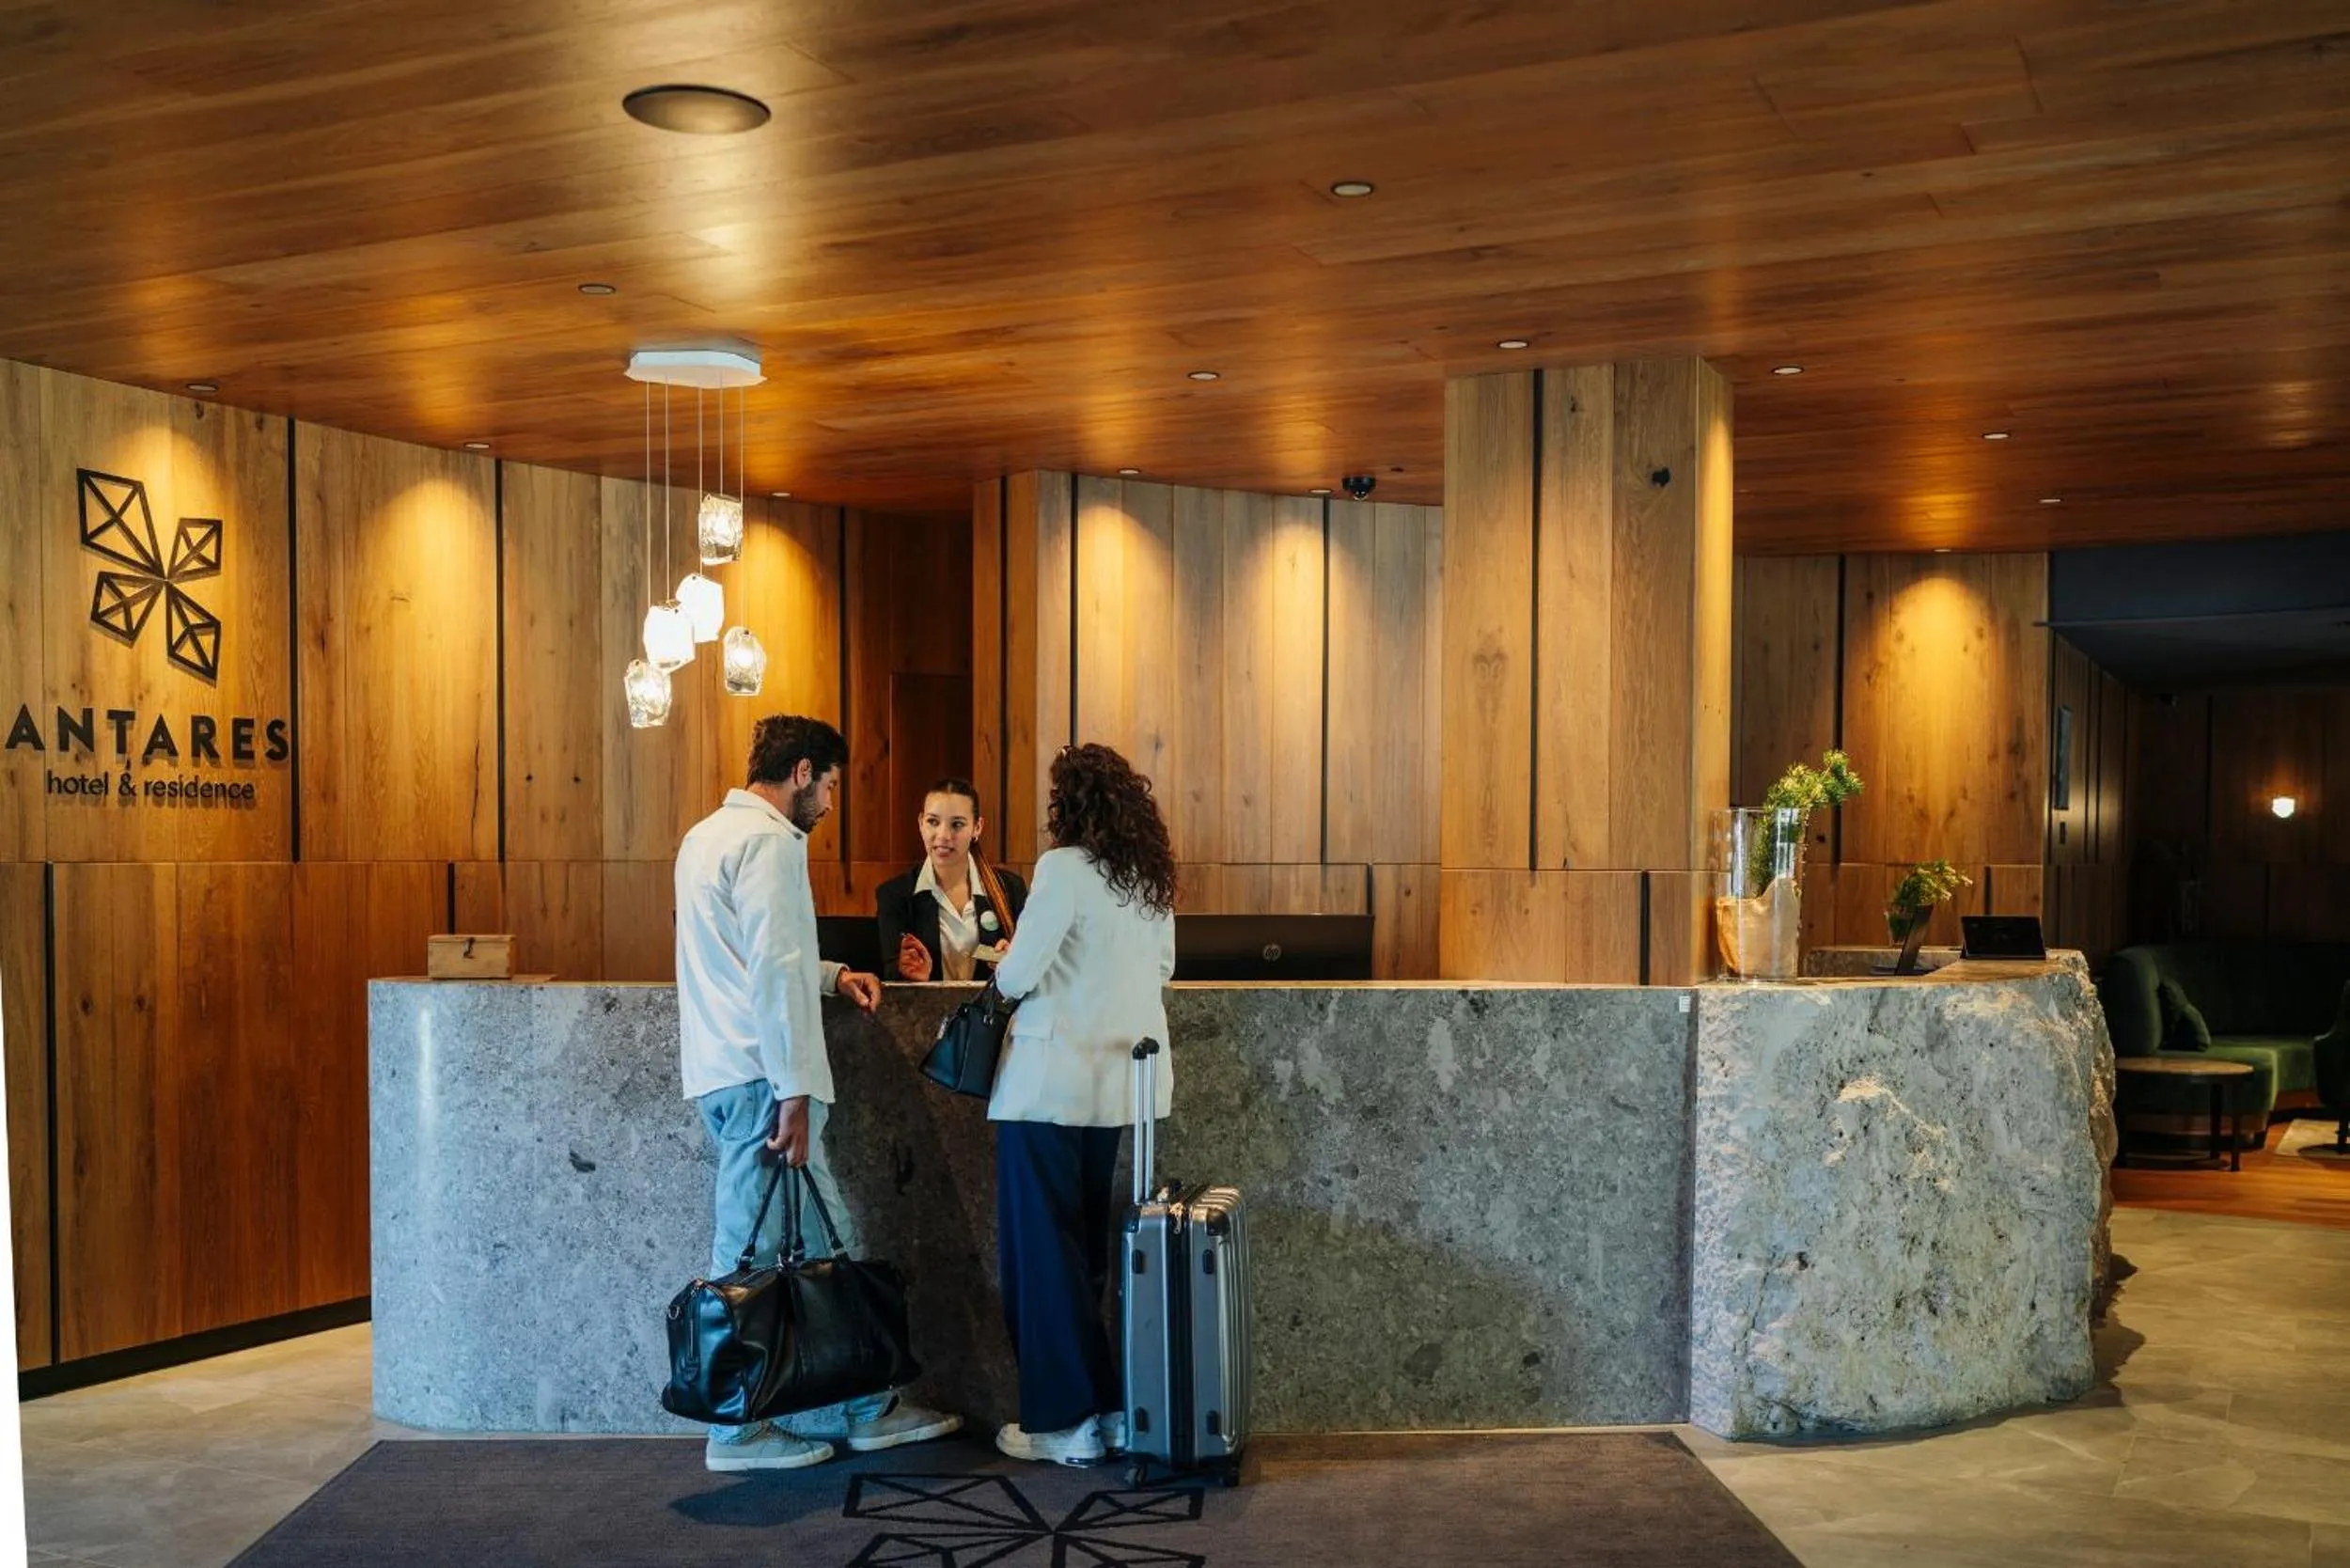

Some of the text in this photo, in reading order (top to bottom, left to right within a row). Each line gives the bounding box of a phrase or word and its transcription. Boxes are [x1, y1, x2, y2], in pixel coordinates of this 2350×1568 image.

[5, 703, 289, 760] ANTARES
[47, 769, 255, 798] hotel & residence
